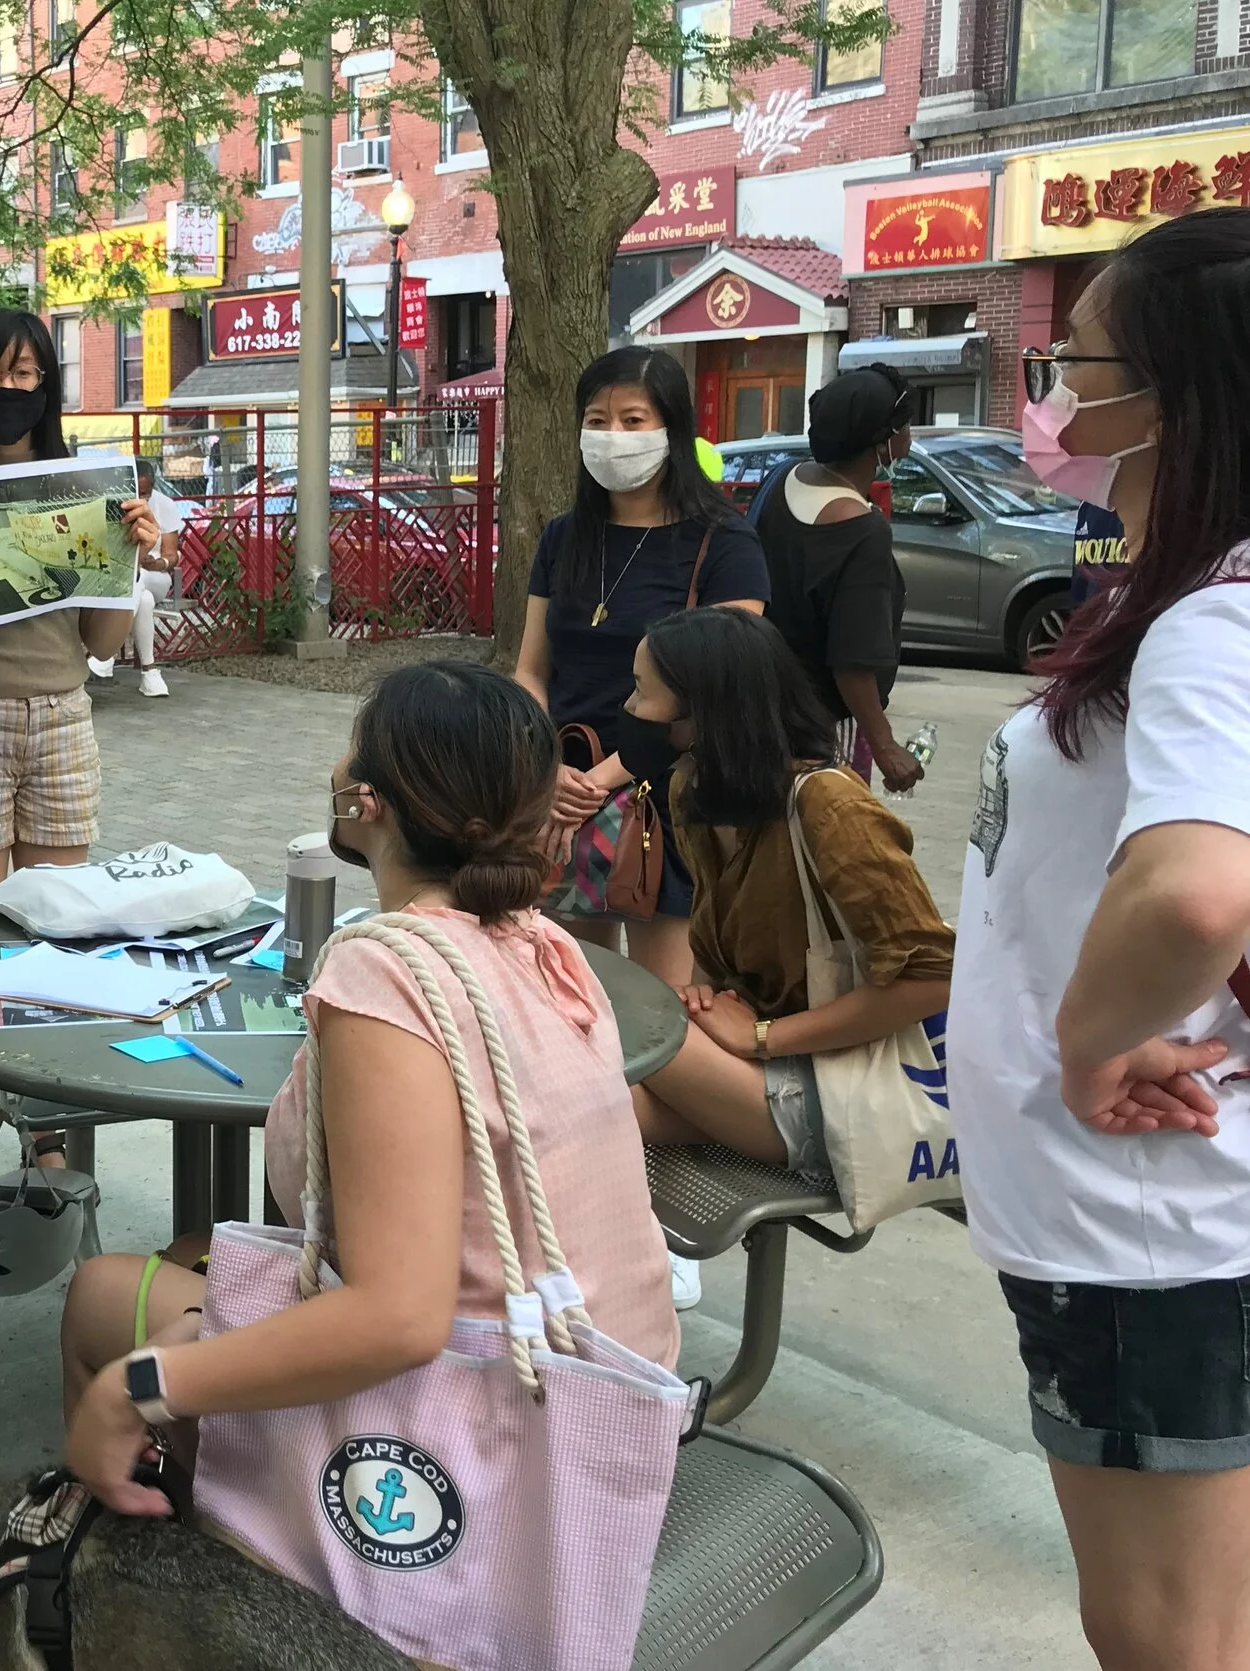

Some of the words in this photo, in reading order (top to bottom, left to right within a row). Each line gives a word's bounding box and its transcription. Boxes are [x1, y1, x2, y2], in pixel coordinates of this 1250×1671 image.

[896, 198, 939, 216] Volleyball
[648, 226, 659, 241] of
[661, 226, 683, 239] New
[685, 218, 727, 238] England
[474, 386, 500, 396] HAPPY
[105, 859, 194, 883] Radio
[345, 1442, 403, 1461] CAPE
[408, 1451, 448, 1493] COD
[326, 1485, 453, 1564] MASSACHUSETTS
